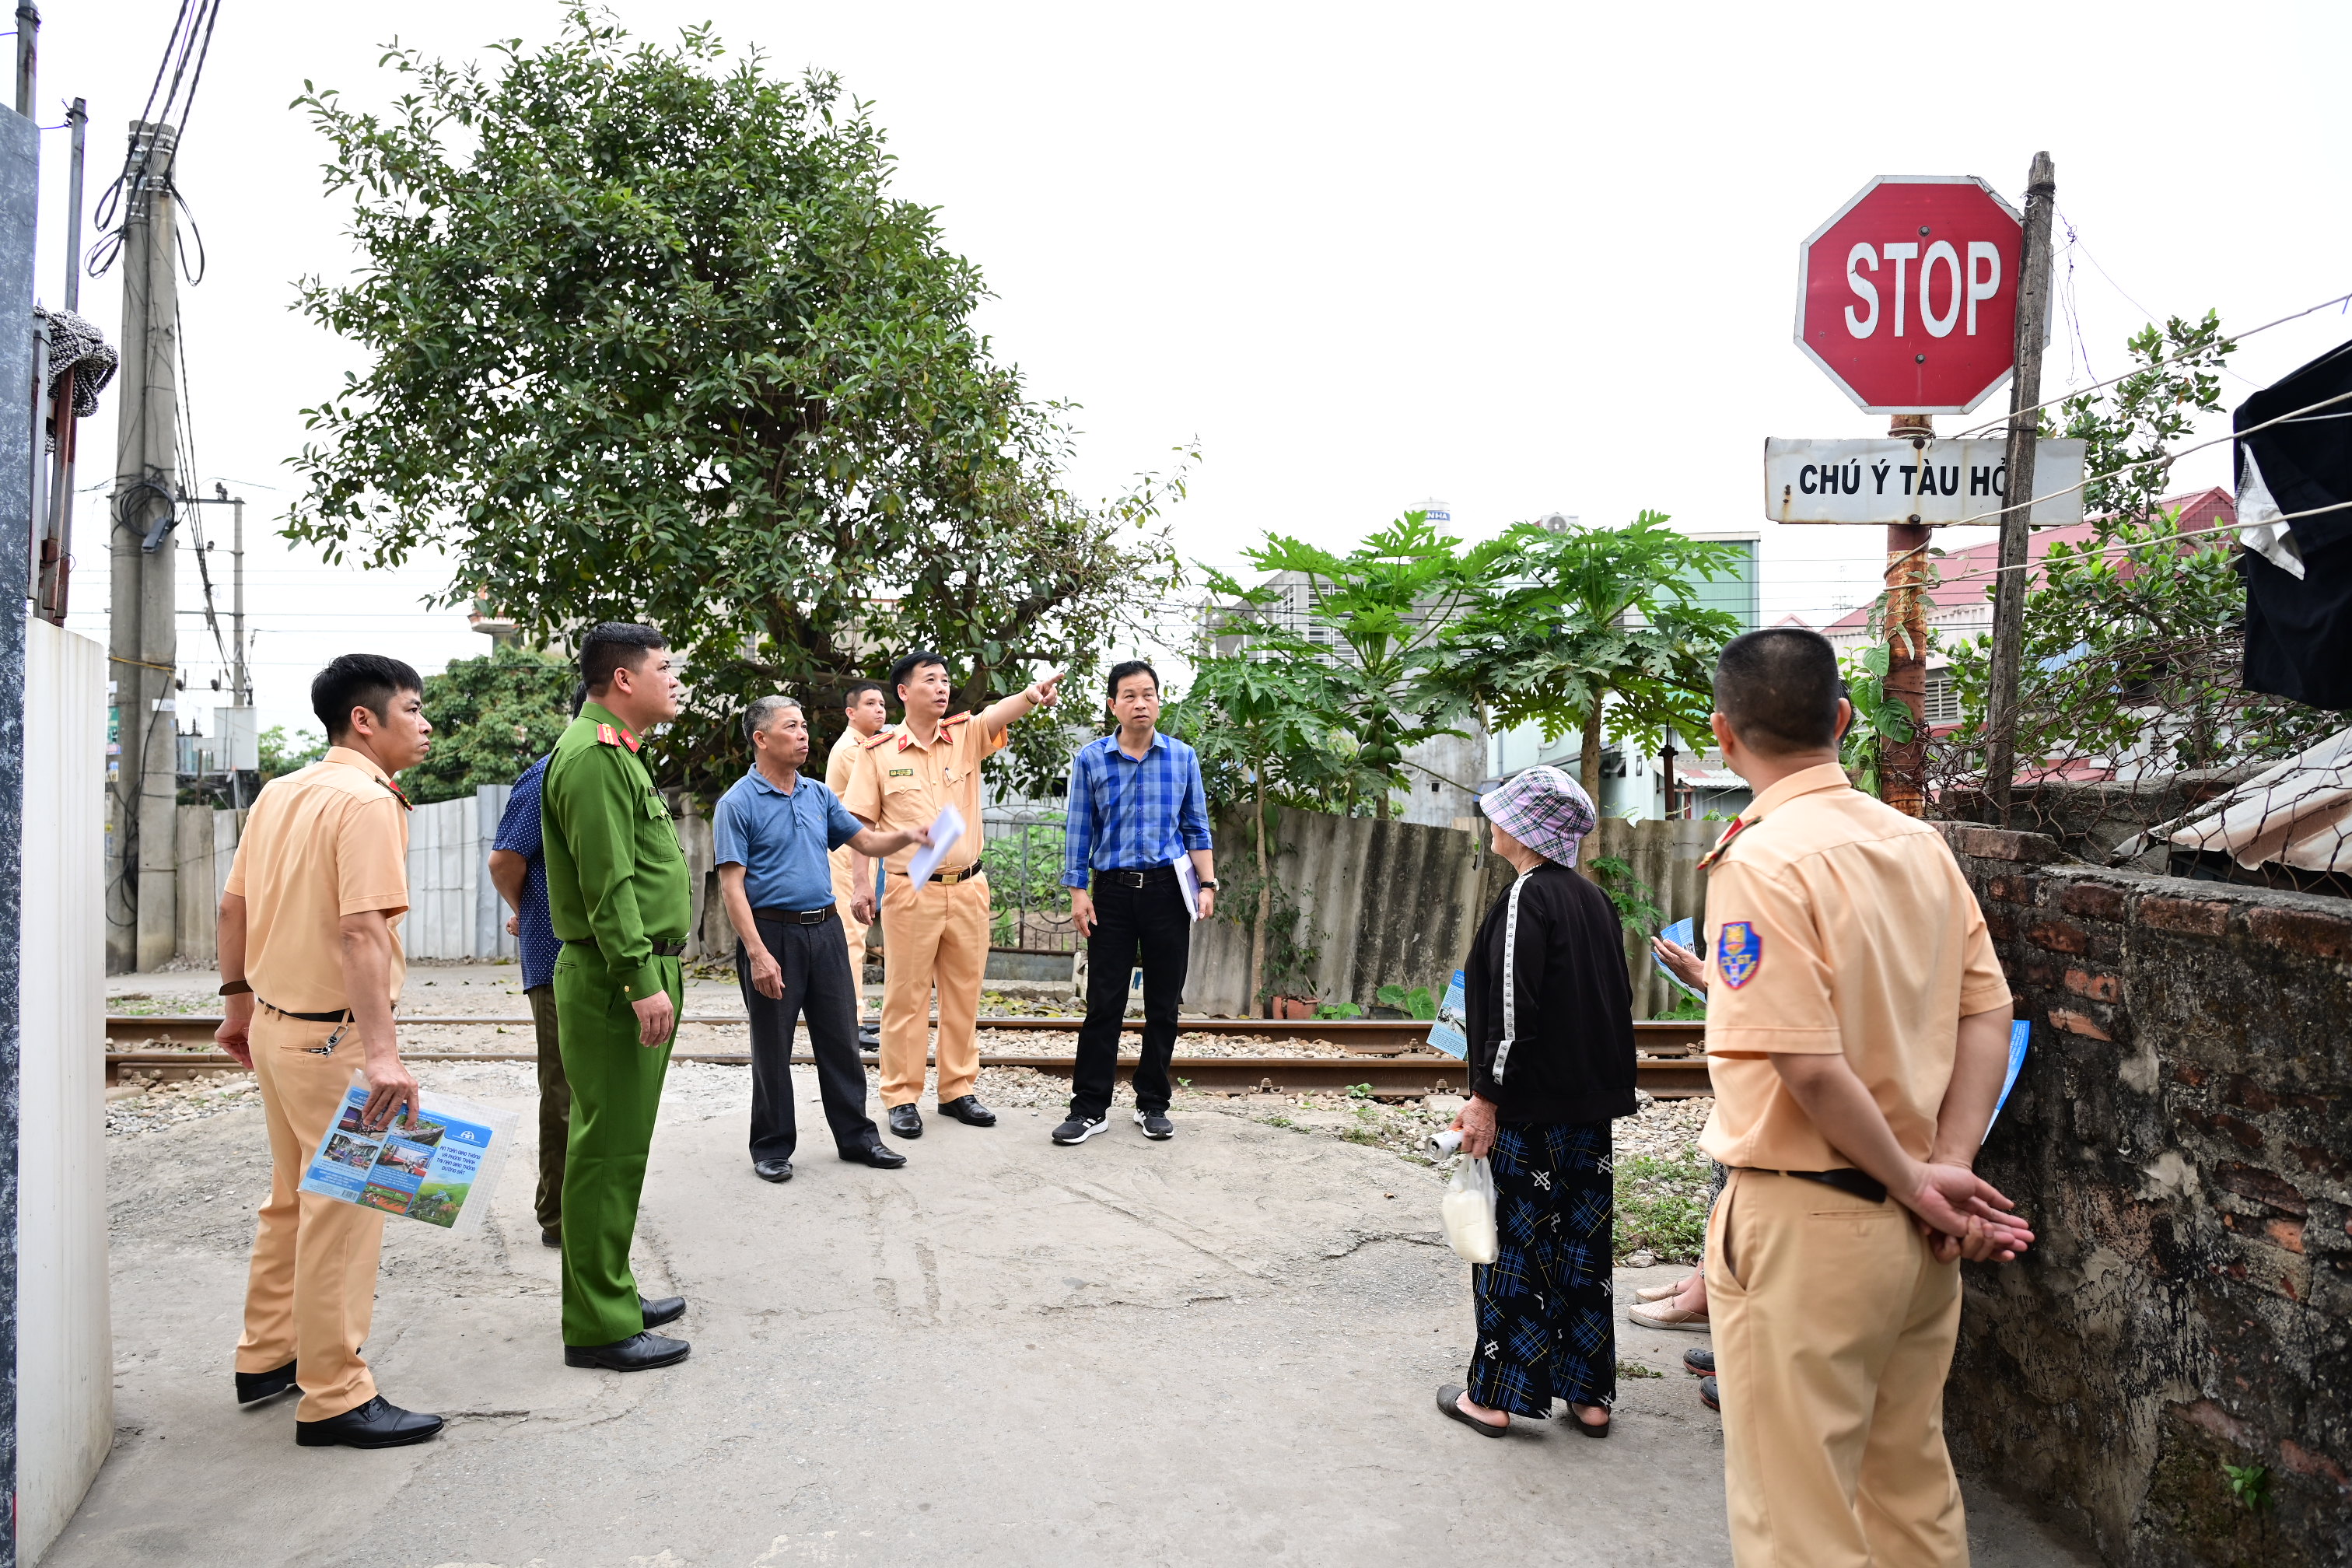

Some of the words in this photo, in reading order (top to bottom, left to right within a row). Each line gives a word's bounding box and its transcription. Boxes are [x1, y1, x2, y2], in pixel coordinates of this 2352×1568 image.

[1844, 240, 2001, 339] STOP
[1799, 458, 1860, 495] CHÚ
[1871, 458, 1891, 495] Ý
[1899, 458, 1959, 495] TÀU
[1970, 457, 2007, 497] HỎ
